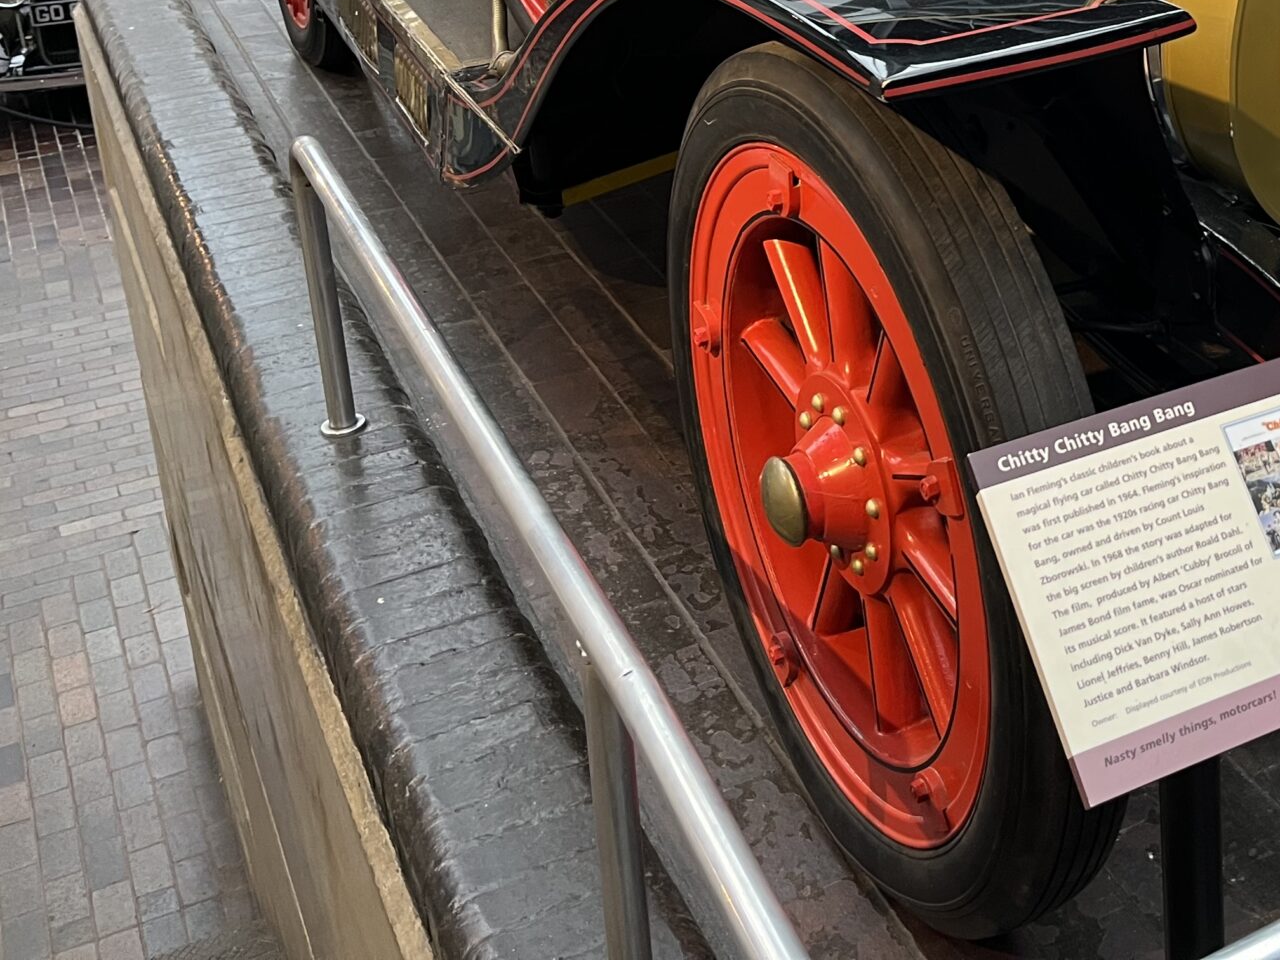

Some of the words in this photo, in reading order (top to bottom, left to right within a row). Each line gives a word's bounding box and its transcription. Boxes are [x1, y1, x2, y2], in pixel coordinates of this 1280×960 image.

[997, 446, 1048, 471] Chitty
[1053, 429, 1103, 453] Chitty
[1107, 415, 1151, 437] Bang
[1152, 401, 1195, 423] Bang
[1009, 491, 1025, 501] Ian
[1069, 466, 1096, 482] classic
[1137, 445, 1161, 460] book
[1162, 437, 1187, 452] about
[1188, 436, 1194, 444] a
[1015, 498, 1051, 518] magical
[1051, 492, 1079, 506] flying
[1079, 486, 1093, 497] car
[1094, 476, 1120, 492] called
[1121, 469, 1147, 483] Chitty
[1148, 460, 1174, 474] Chitty
[1175, 452, 1198, 465] Bang
[1197, 445, 1220, 458] Bang
[1021, 522, 1041, 534] was
[1041, 515, 1061, 528] first
[1062, 499, 1106, 523] published
[1105, 497, 1116, 506] in
[1181, 461, 1226, 481] inspiration
[1027, 541, 1041, 551] for
[1043, 535, 1059, 546] the
[1060, 529, 1074, 540] car
[1075, 523, 1095, 535] was
[1095, 517, 1111, 528] the
[1112, 508, 1138, 522] 1920s
[1138, 499, 1166, 514] racing
[1166, 494, 1179, 504] car
[1180, 485, 1206, 499] Chitty
[1206, 477, 1229, 490] Bang
[1061, 540, 1093, 558] owned
[1094, 534, 1112, 547] and
[1112, 526, 1141, 541] driven
[1141, 521, 1153, 531] by
[1154, 511, 1182, 526] Count
[1181, 503, 1205, 517] Louis
[1089, 558, 1101, 567] In
[1101, 548, 1123, 563] 1968
[1123, 545, 1140, 556] the
[1140, 536, 1163, 550] story
[1163, 530, 1183, 541] was
[1183, 515, 1218, 535] adapted
[1218, 512, 1232, 522] for
[1045, 591, 1062, 602] the
[1062, 585, 1079, 596] big
[1079, 575, 1109, 591] screen
[1108, 569, 1121, 580] by
[1165, 544, 1193, 560] author
[1194, 533, 1220, 549] Roald
[1050, 608, 1069, 619] The
[1095, 581, 1138, 606] produced
[1137, 578, 1150, 589] by
[1152, 567, 1180, 584] Albert
[1243, 539, 1253, 550] of
[1058, 621, 1086, 637] James
[1087, 609, 1112, 626] Bond
[1112, 605, 1131, 617] film
[1158, 588, 1177, 600] was
[1177, 578, 1202, 593] Oscar
[1203, 560, 1249, 584] nominated
[1249, 556, 1262, 566] for
[1063, 644, 1076, 655] its
[1077, 629, 1112, 650] musical
[1139, 617, 1148, 626] It
[1148, 601, 1187, 623] featured
[1188, 601, 1195, 609] a
[1194, 592, 1215, 606] host
[1215, 586, 1225, 598] of
[1226, 581, 1247, 594] stars
[1069, 650, 1113, 672] including
[1113, 641, 1134, 656] Dick
[1133, 635, 1153, 647] Van
[1179, 616, 1201, 631] Sally
[1203, 610, 1221, 623] Ann
[1076, 671, 1107, 688] Lionel
[1141, 648, 1170, 665] Benny
[1191, 630, 1218, 647] James
[1218, 614, 1262, 636] Robertson
[1083, 690, 1114, 708] Justice
[1115, 680, 1133, 695] and
[1133, 669, 1170, 688] Barbara
[1103, 747, 1136, 767] Nasty
[1139, 731, 1175, 753] smelly
[1178, 716, 1216, 736] things,
[1219, 689, 1276, 720] motorcars!
